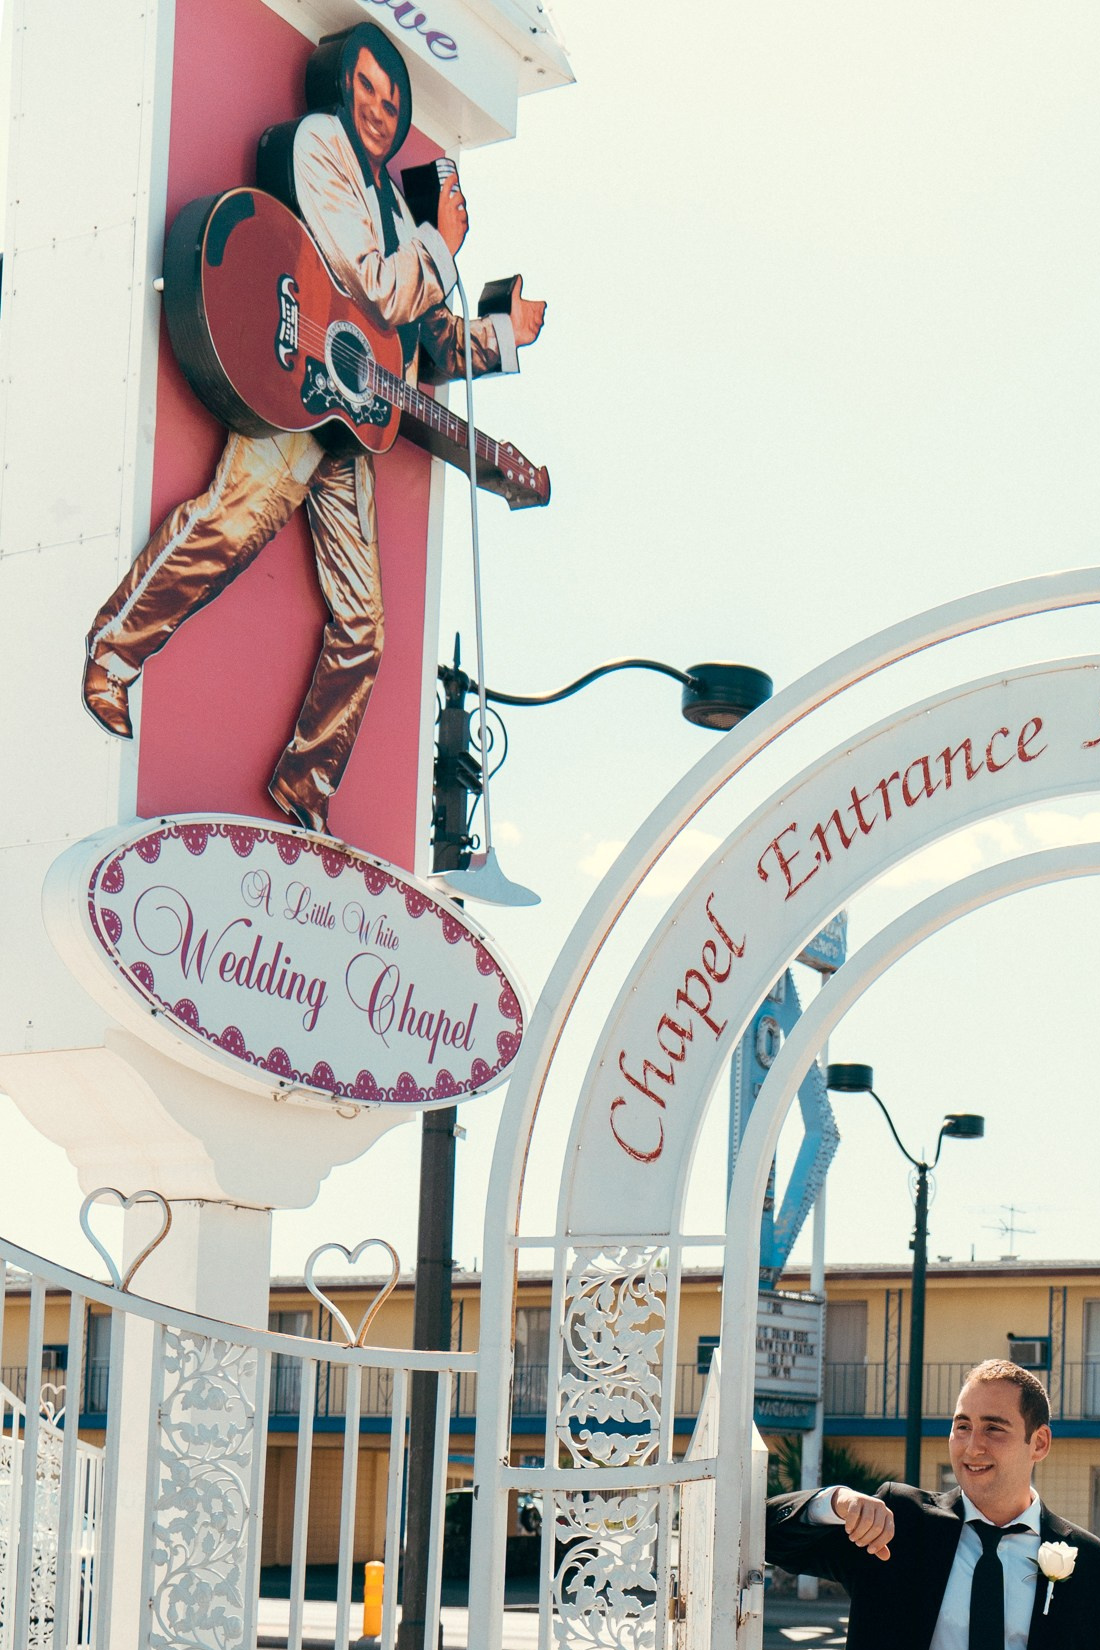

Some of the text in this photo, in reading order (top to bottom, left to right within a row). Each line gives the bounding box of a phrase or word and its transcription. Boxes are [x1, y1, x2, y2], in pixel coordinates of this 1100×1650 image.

[133, 886, 478, 1064] Wedding Chapel
[241, 869, 399, 950] A Little White
[610, 893, 747, 1164] Chapel
[757, 716, 1046, 900] Entrance
